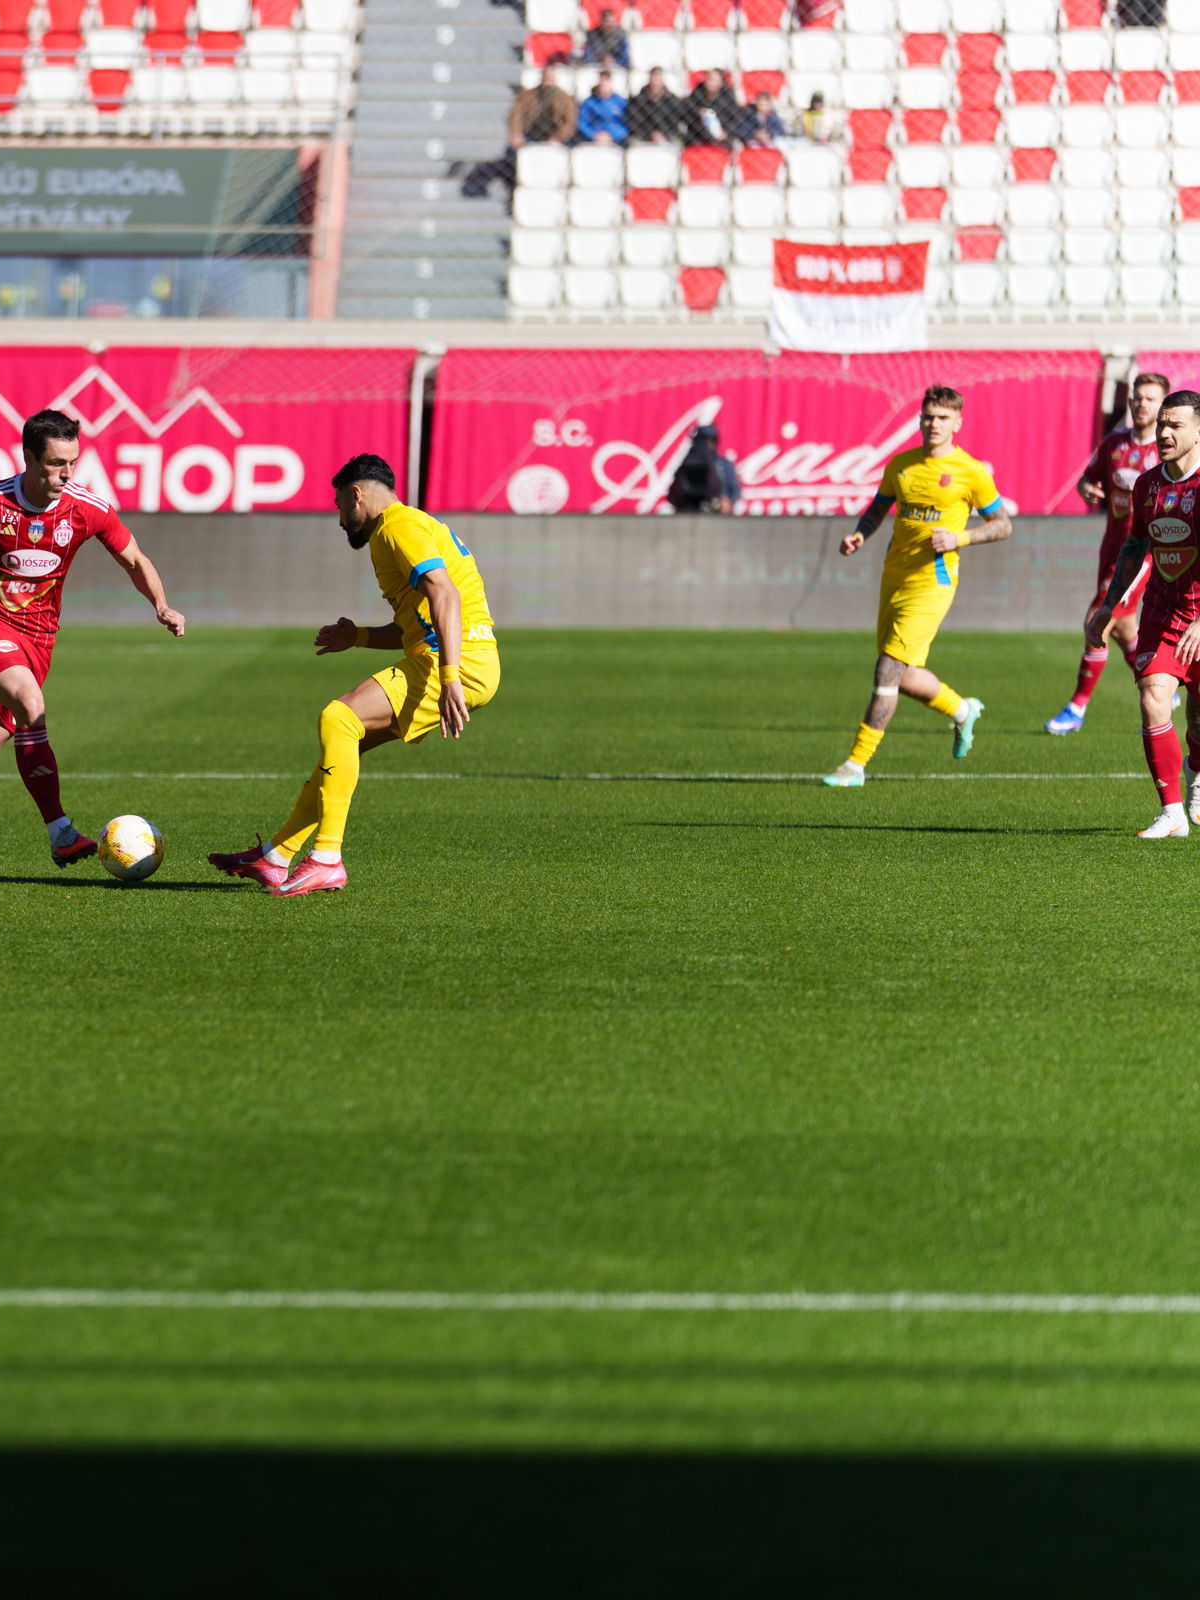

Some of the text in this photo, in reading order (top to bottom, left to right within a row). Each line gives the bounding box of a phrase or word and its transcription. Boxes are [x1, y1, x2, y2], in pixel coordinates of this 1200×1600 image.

[46, 160, 186, 195] EURÓPA
[532, 419, 594, 447] S.C.
[1160, 552, 1182, 565] MOL
